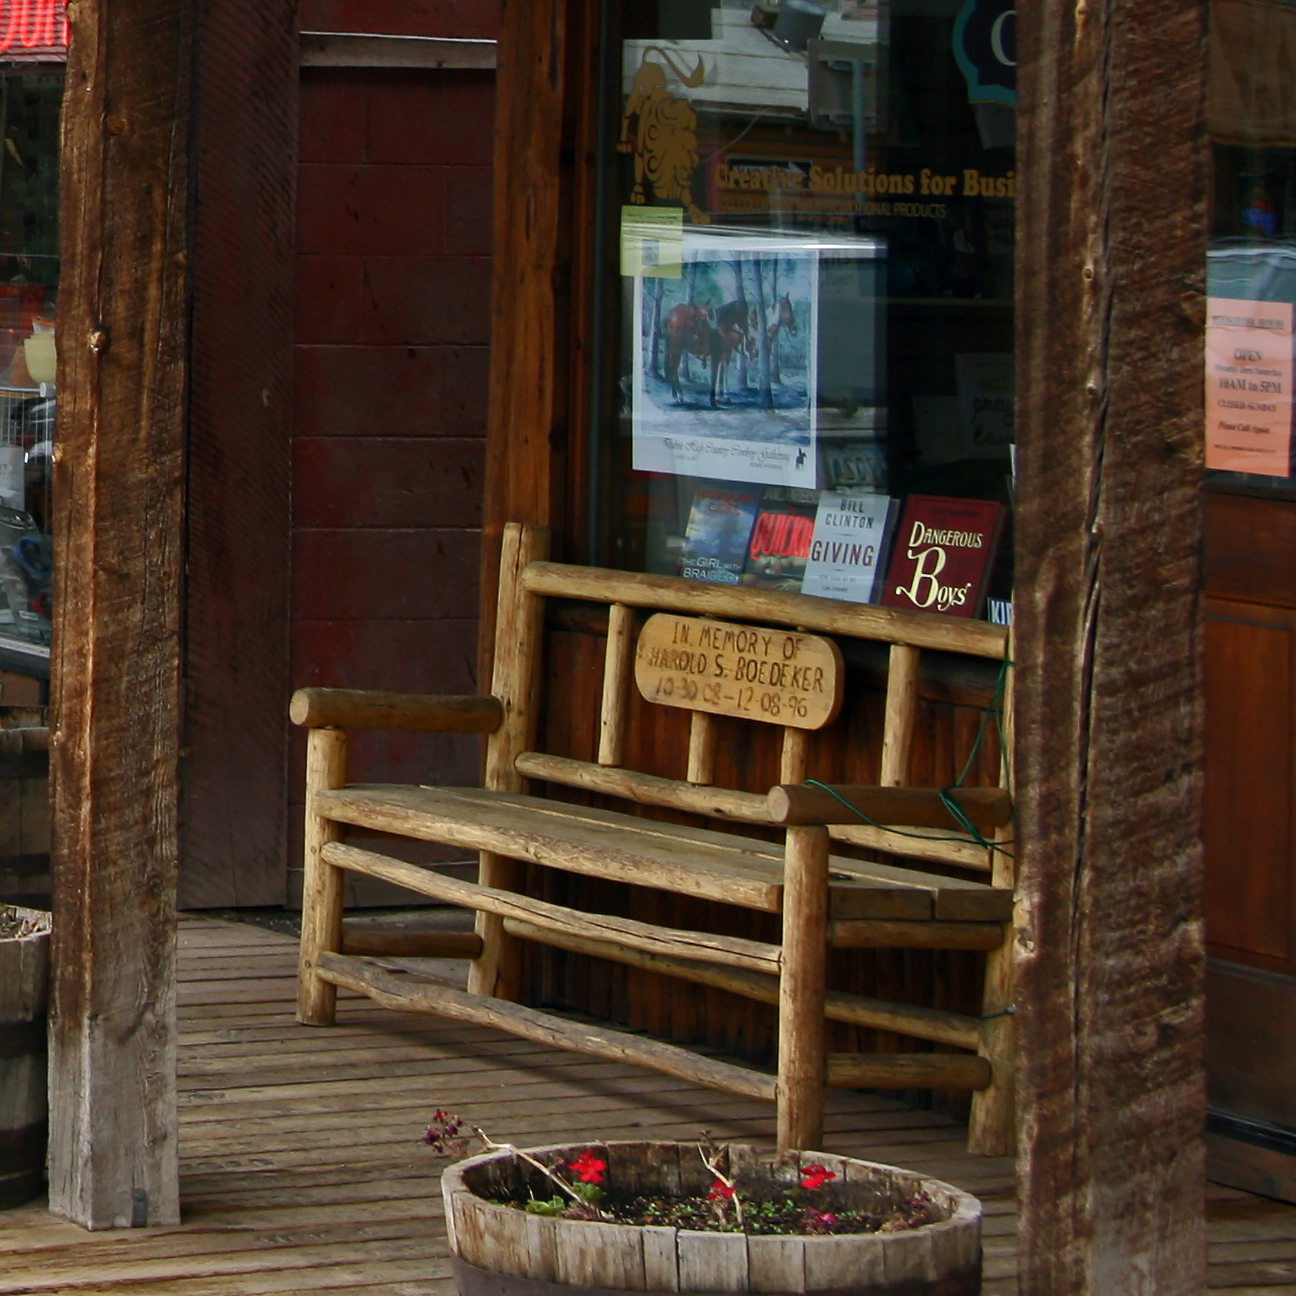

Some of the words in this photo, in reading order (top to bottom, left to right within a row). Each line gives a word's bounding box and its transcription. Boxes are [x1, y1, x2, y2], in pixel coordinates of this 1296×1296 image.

[712, 163, 805, 191] Creative
[809, 164, 916, 195] Solutions
[919, 168, 959, 196] for
[962, 169, 1016, 198] Busi
[1234, 348, 1263, 362] OPEN
[1219, 377, 1247, 391] 10AM
[840, 499, 865, 513] BILL
[825, 513, 874, 529] CLINTON
[908, 520, 984, 549] DANGEROUS
[696, 556, 723, 569] GIRL
[811, 540, 874, 567] GIVING
[699, 623, 773, 657] MEMORY
[782, 636, 804, 661] OF
[648, 646, 707, 674] HAROLD
[734, 655, 824, 693] BOEDEKER
